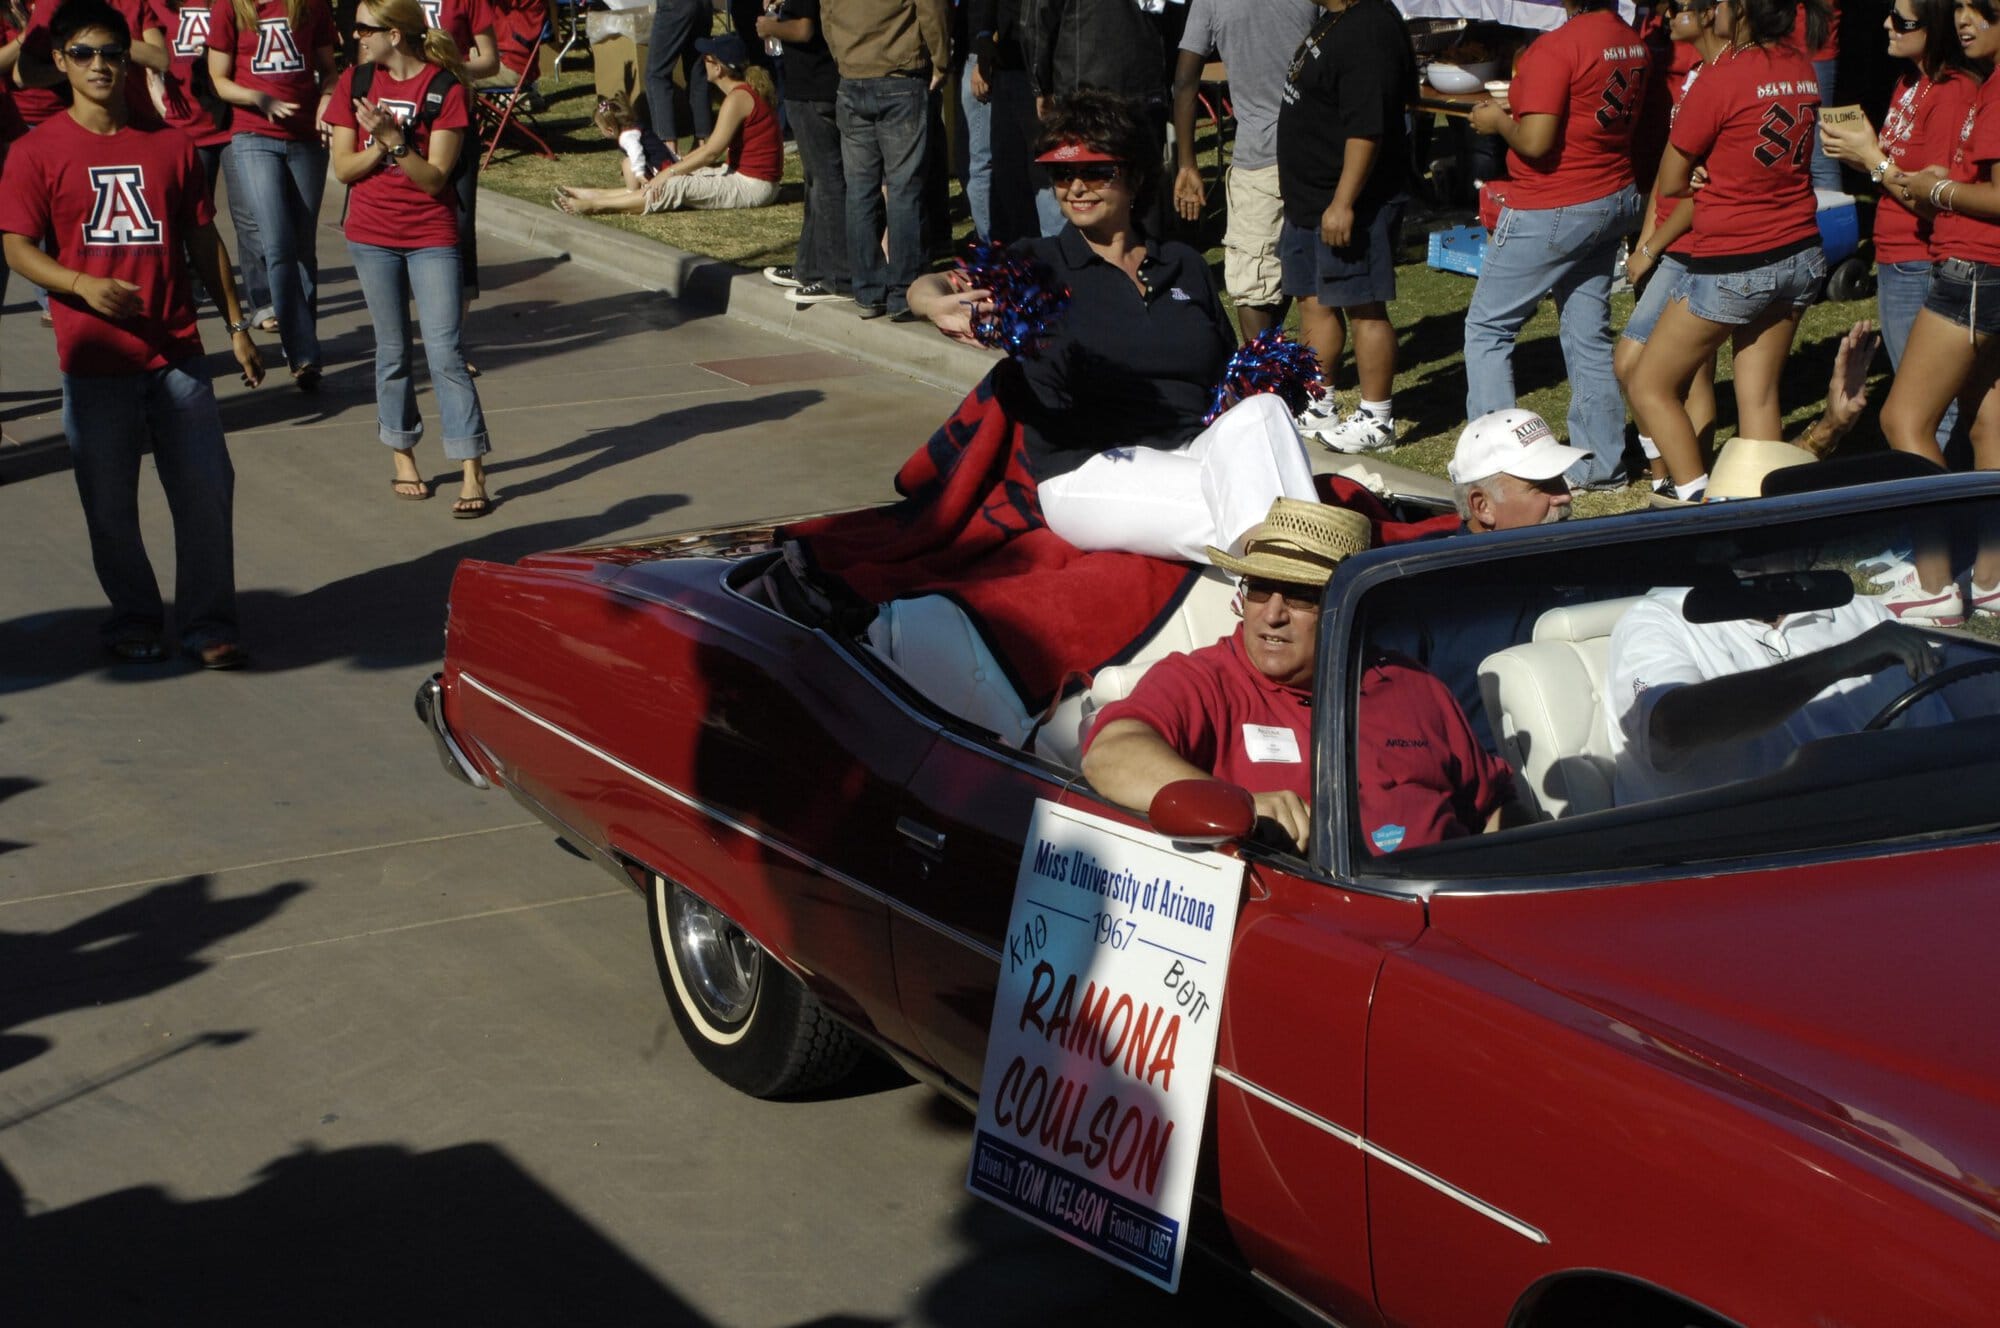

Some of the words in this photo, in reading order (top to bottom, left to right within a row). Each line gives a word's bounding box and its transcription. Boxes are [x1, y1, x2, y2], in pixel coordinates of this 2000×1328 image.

[251, 17, 305, 75] A
[1757, 82, 1793, 99] DELTA
[1822, 113, 1834, 124] GO
[1753, 102, 1820, 168] 87
[82, 165, 163, 246] A
[1032, 839, 1070, 882] Miss
[1070, 850, 1141, 914] University
[1142, 877, 1160, 913] of
[1158, 879, 1216, 931] Arizona
[1093, 912, 1137, 951] 1967
[1019, 959, 1181, 1092] RAMONA
[994, 1055, 1175, 1196] COULSON
[978, 1149, 1002, 1182] Driven
[1001, 1159, 1015, 1189] by
[1014, 1159, 1048, 1206] TOM
[1046, 1175, 1109, 1237] NELSON
[1109, 1209, 1146, 1250] Football
[1149, 1229, 1172, 1262] 1967
